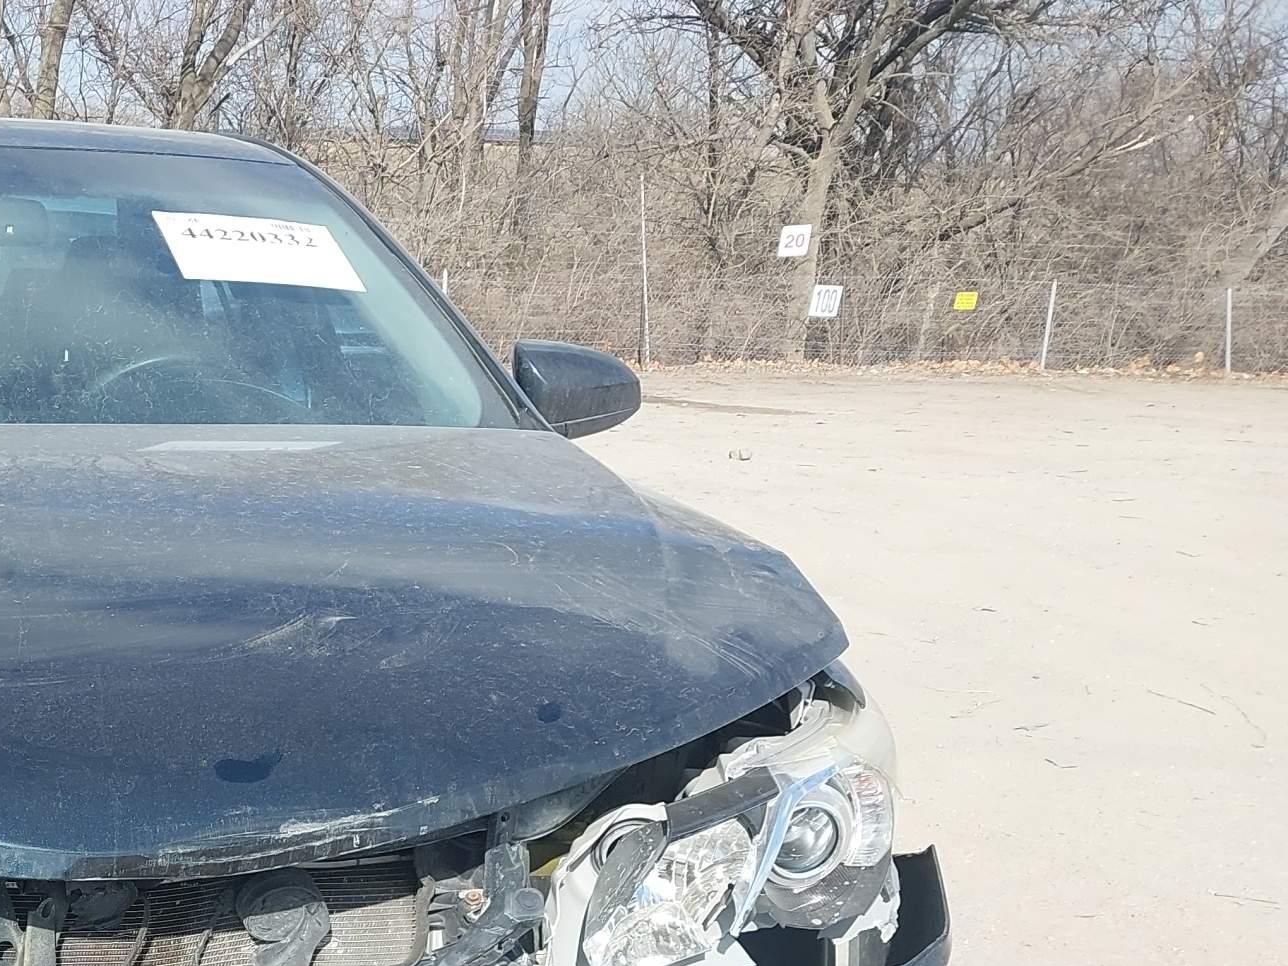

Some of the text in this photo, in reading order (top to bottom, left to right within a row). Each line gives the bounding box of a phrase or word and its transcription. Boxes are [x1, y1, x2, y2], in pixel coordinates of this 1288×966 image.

[180, 226, 319, 248] 44220332
[784, 233, 805, 249] 20
[815, 289, 838, 313] 100
